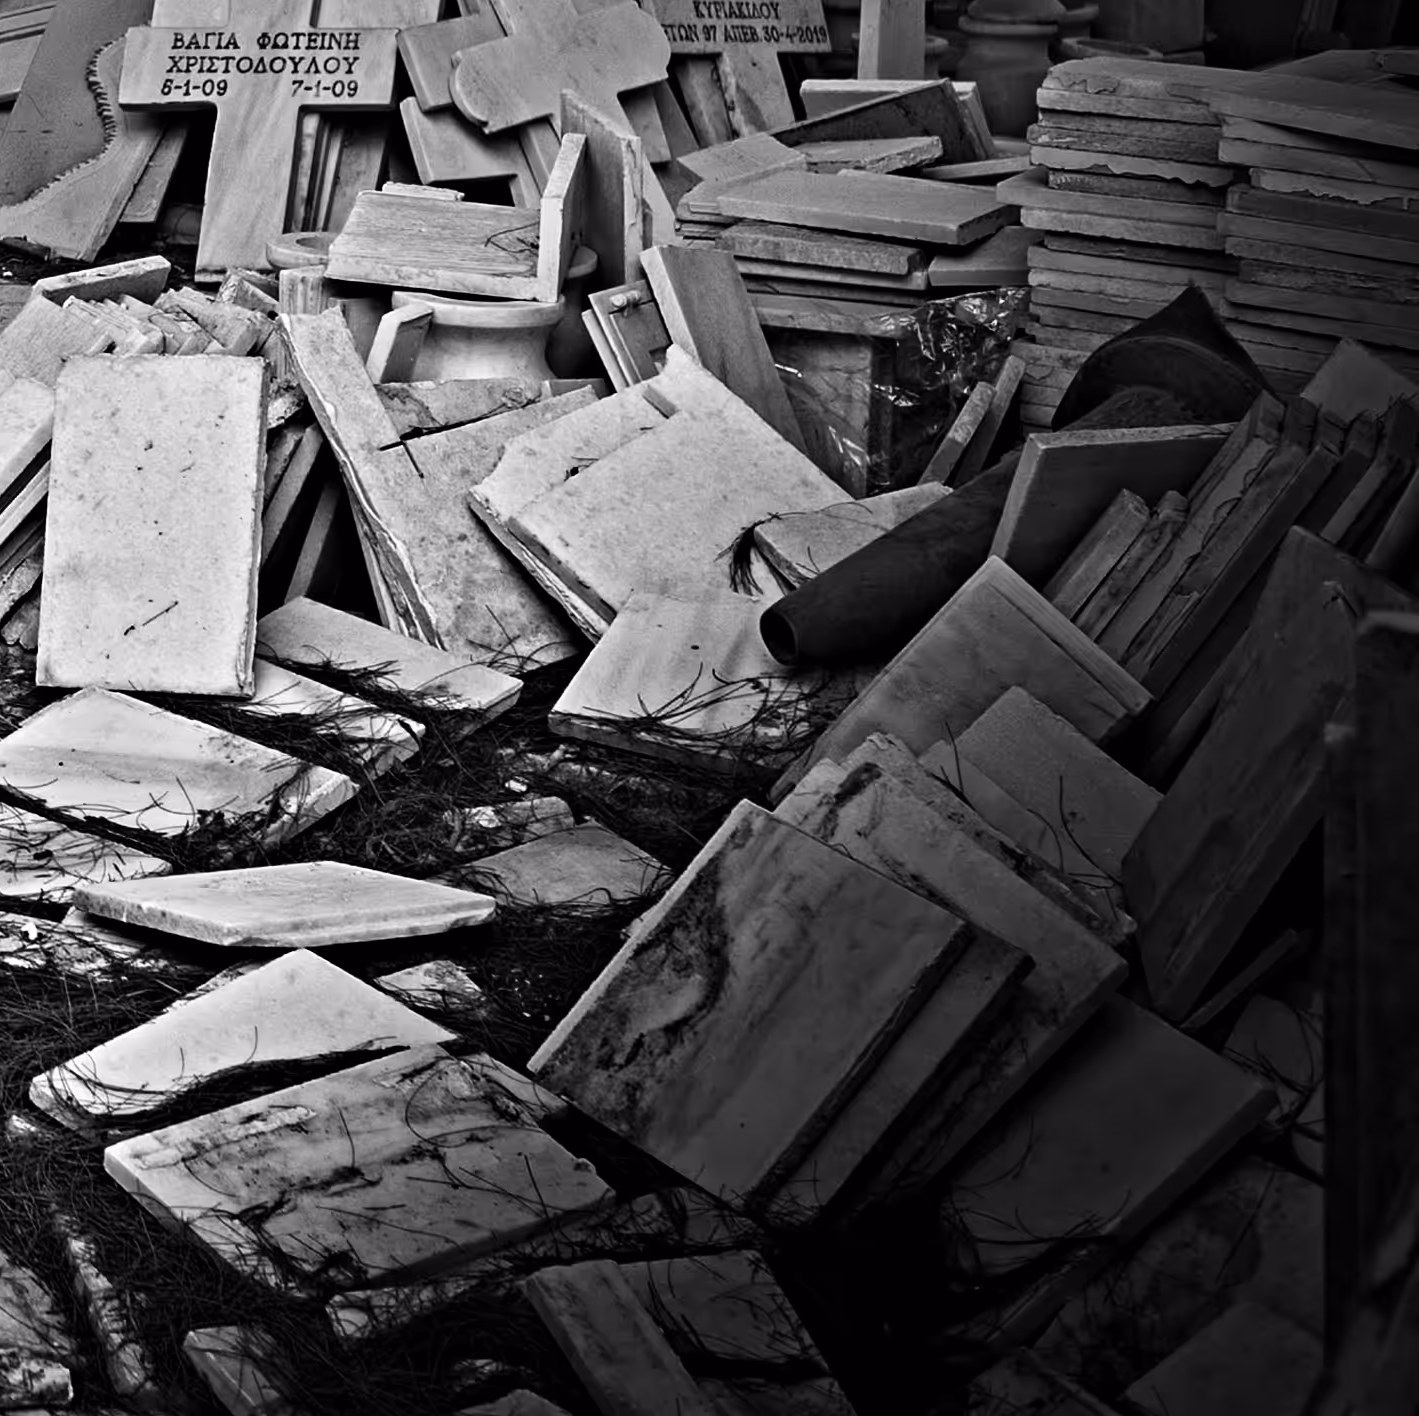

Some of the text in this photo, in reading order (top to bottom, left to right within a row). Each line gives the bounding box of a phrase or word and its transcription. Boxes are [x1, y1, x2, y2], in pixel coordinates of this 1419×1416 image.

[692, 0, 780, 20] ΚΥΡΙΑΚΙΔΟΥ
[171, 32, 360, 51] ΒΑΓΙΑ ΦΩΤΕΙΝΗ
[702, 24, 717, 42] 97
[166, 55, 360, 74] ΧΡΙΣΤΟΔΟΥΛΟΥ
[291, 78, 359, 98] 7-1-09
